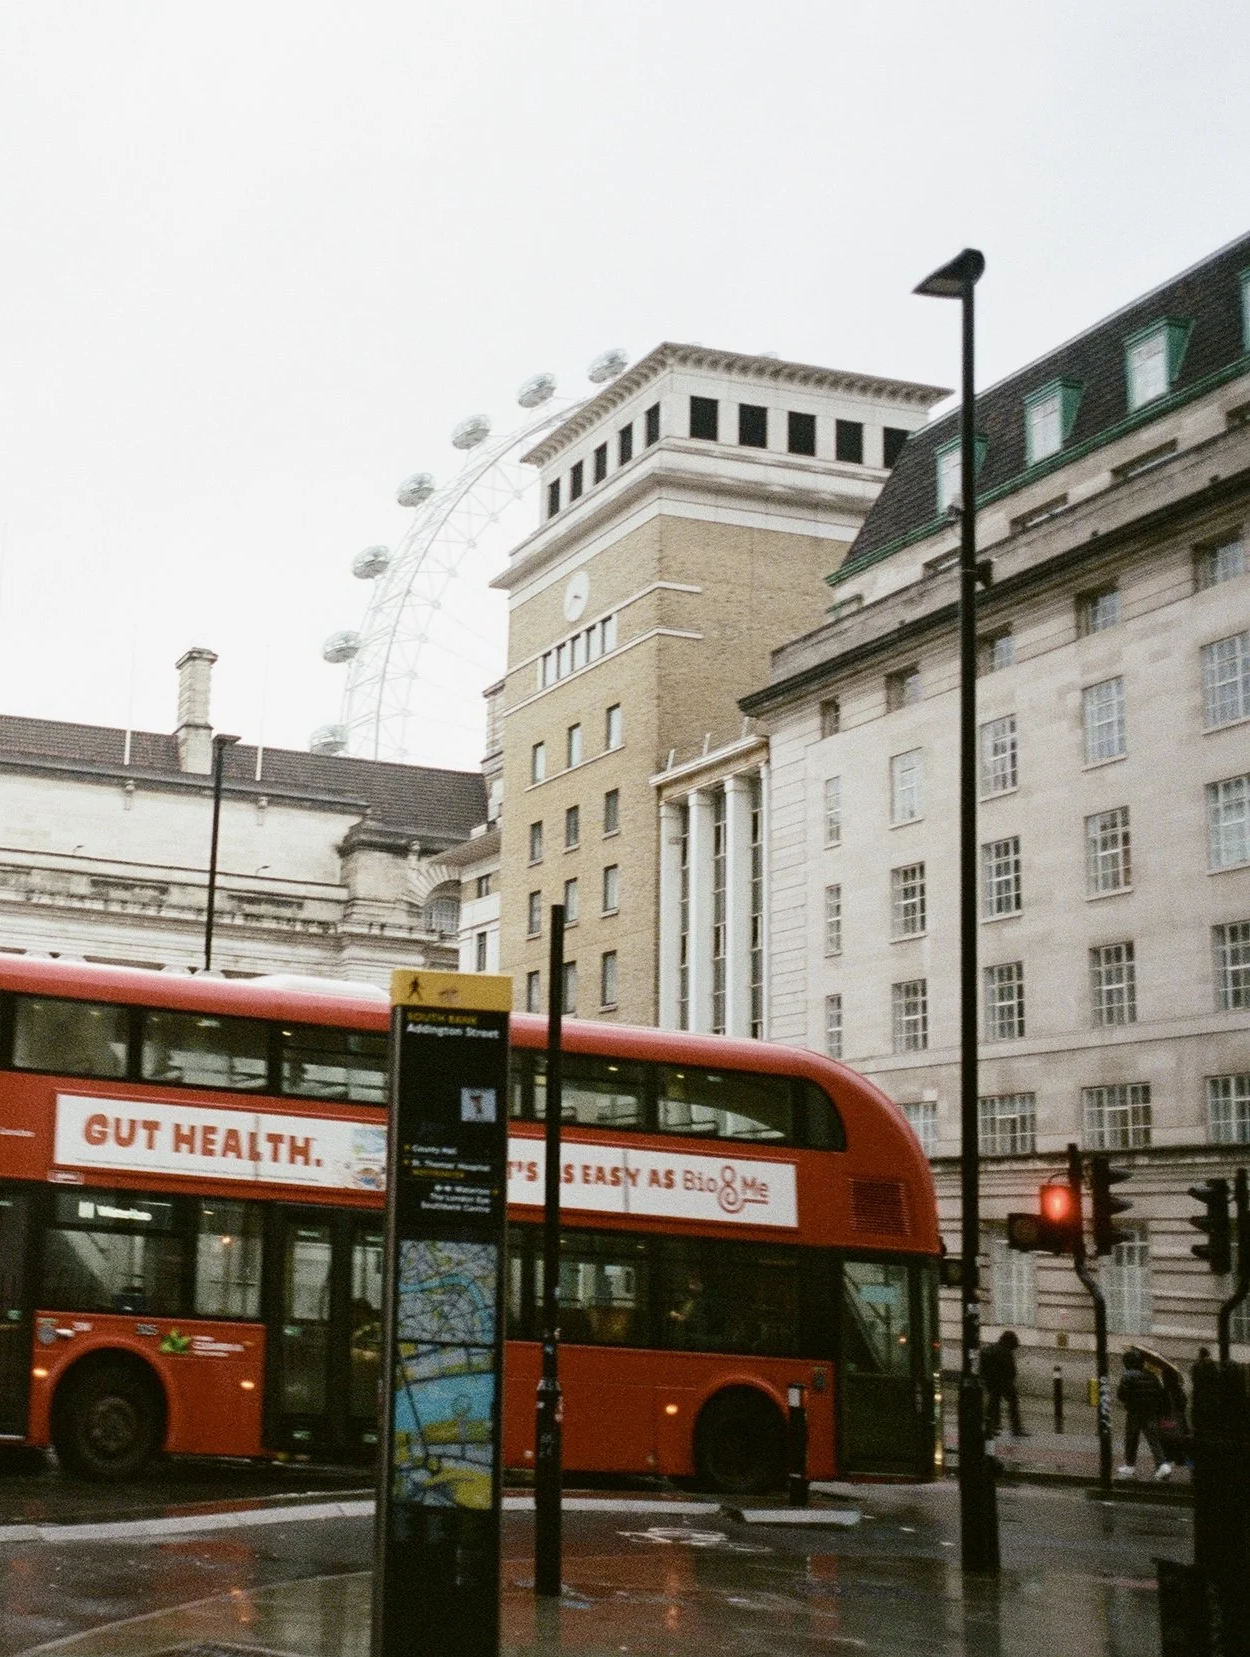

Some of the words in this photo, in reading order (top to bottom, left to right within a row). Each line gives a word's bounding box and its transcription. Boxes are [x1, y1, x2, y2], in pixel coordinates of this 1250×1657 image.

[406, 1024, 463, 1037] Addington
[465, 1027, 499, 1039] Street
[84, 1113, 161, 1150] GUT
[173, 1123, 324, 1168] HEALTH.
[507, 1161, 538, 1182] T'S
[581, 1164, 640, 1187] EASY
[648, 1168, 675, 1189] AS
